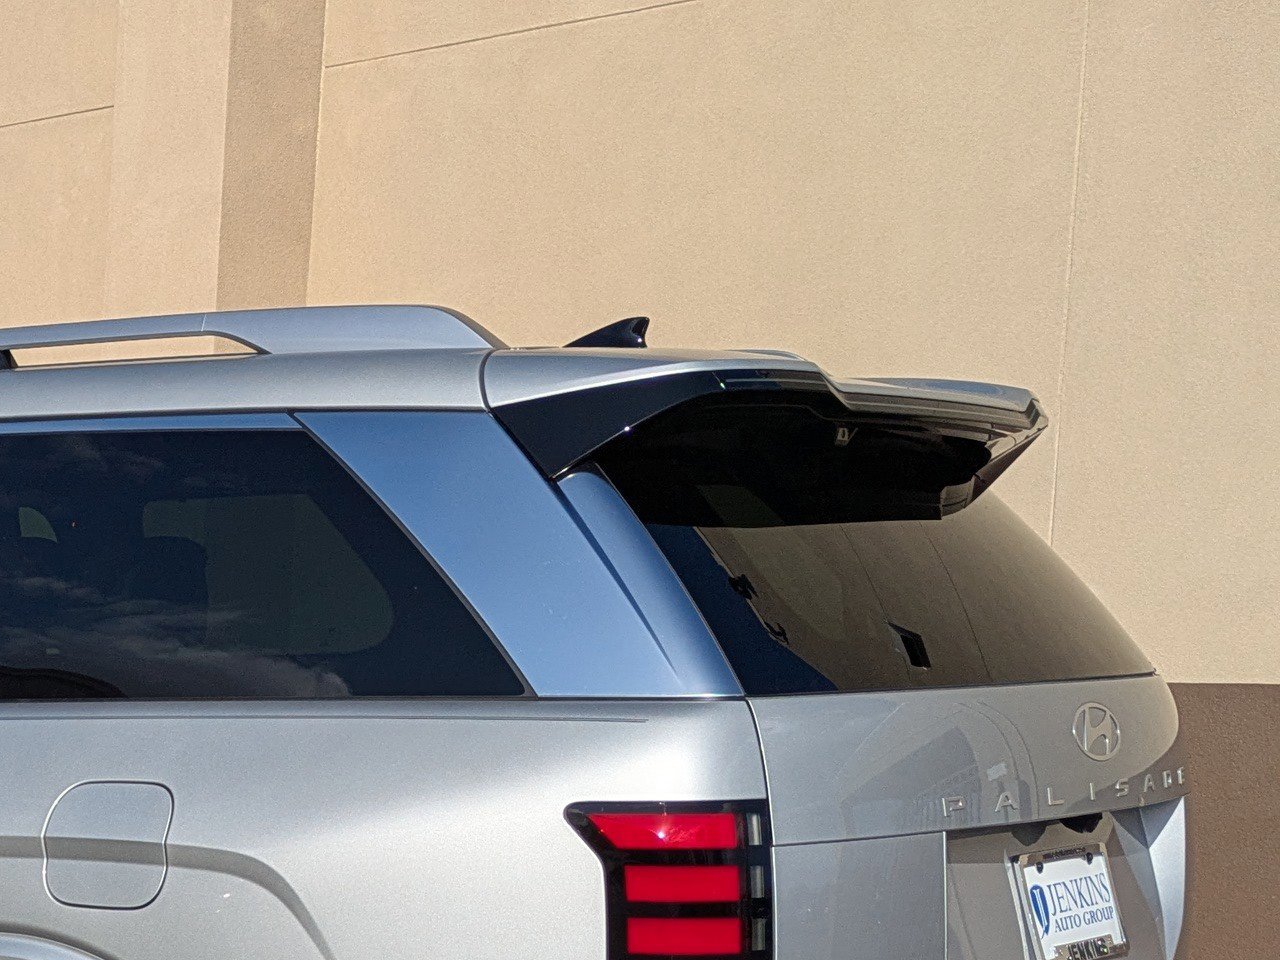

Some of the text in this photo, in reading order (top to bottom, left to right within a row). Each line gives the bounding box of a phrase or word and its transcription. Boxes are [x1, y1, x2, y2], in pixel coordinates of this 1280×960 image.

[941, 766, 1186, 817] PALISADE
[1047, 872, 1111, 917] JENKINS
[1054, 906, 1114, 933] AUTO GROUP
